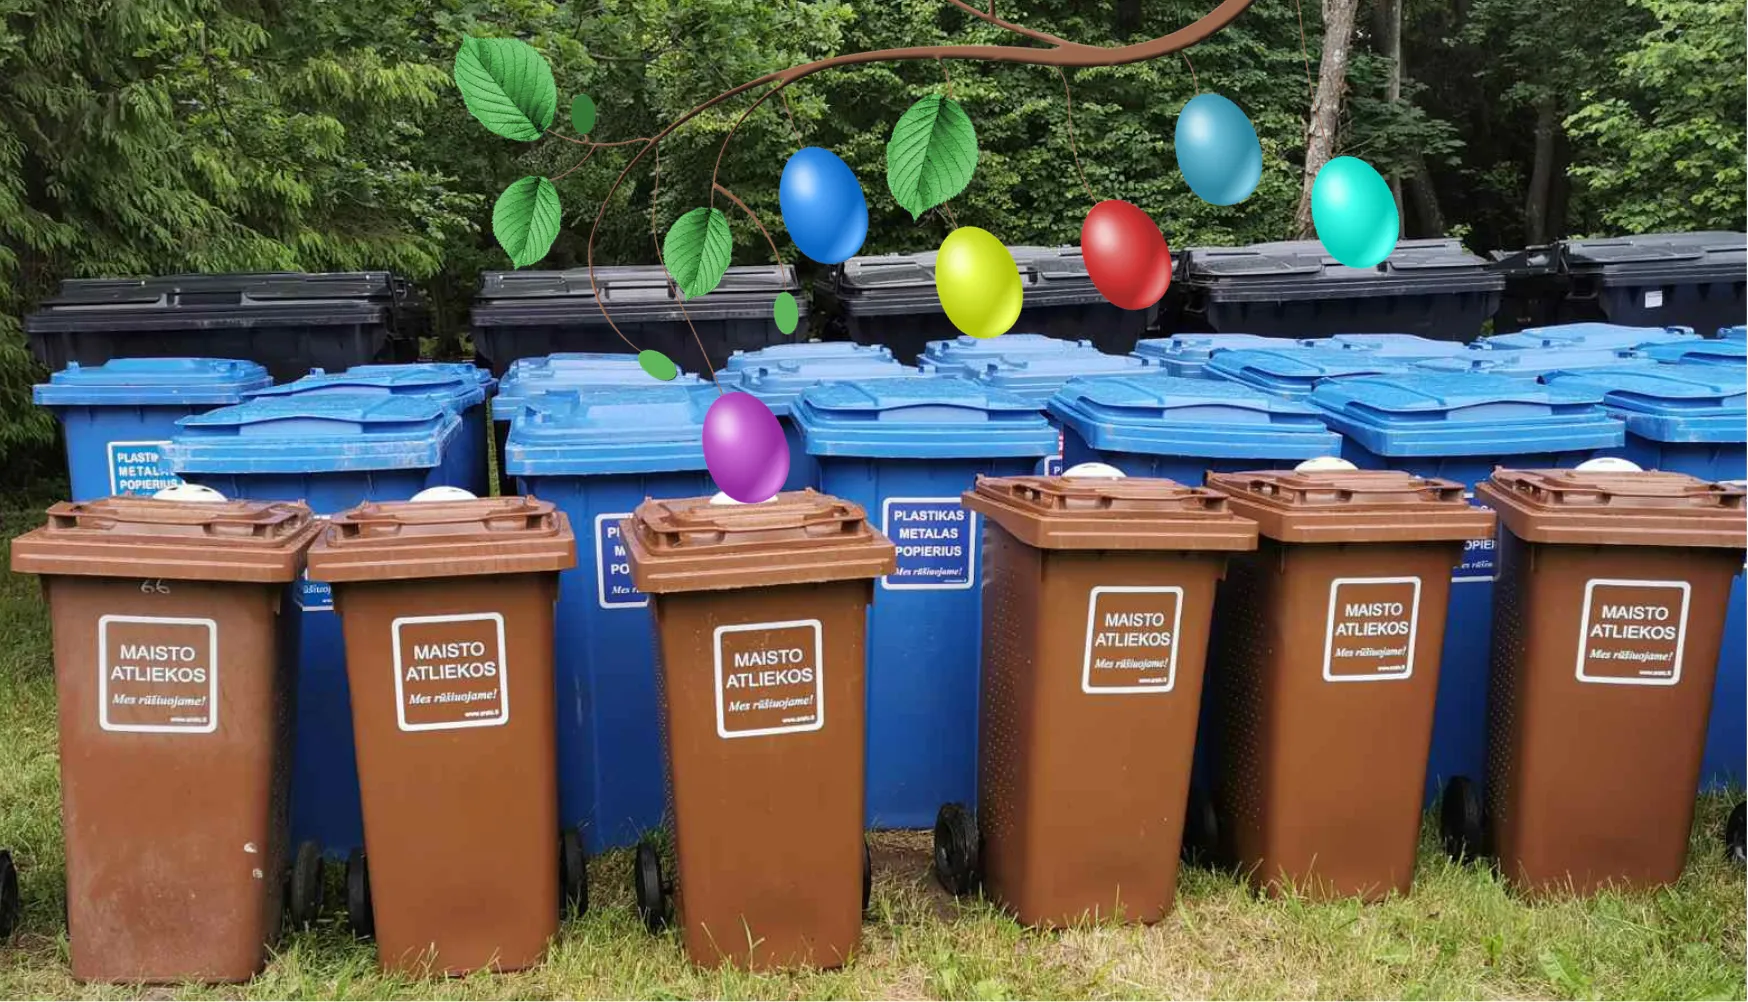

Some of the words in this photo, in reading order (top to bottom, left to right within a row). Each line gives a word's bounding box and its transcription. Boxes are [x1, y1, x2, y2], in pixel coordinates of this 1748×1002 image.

[894, 510, 965, 521] PLASTIKAS
[899, 528, 958, 539] METALAS
[895, 546, 962, 557] POPIERIUS
[140, 579, 171, 594] 66
[612, 585, 630, 594] Mes
[1345, 602, 1403, 617] MAISTO
[1602, 605, 1669, 620] MAISTO
[1105, 612, 1165, 627] MAISTO
[1335, 621, 1409, 636] ATLIEKOS
[1590, 624, 1676, 640] ATLIEKOS
[1095, 632, 1171, 647] ATLIEKOS
[120, 644, 195, 661] MAISTO
[413, 642, 485, 660] MAISTO
[734, 648, 803, 668] MAISTO
[1335, 648, 1353, 657] Mes
[1589, 649, 1611, 659] Mes
[405, 661, 496, 681] ATLIEKOS
[1095, 658, 1114, 669] Mes
[110, 666, 206, 683] ATLIEKOS
[726, 668, 813, 689] ATLIEKOS
[112, 694, 136, 705] Mes
[409, 693, 431, 705] Mes
[728, 701, 751, 712] Mes
